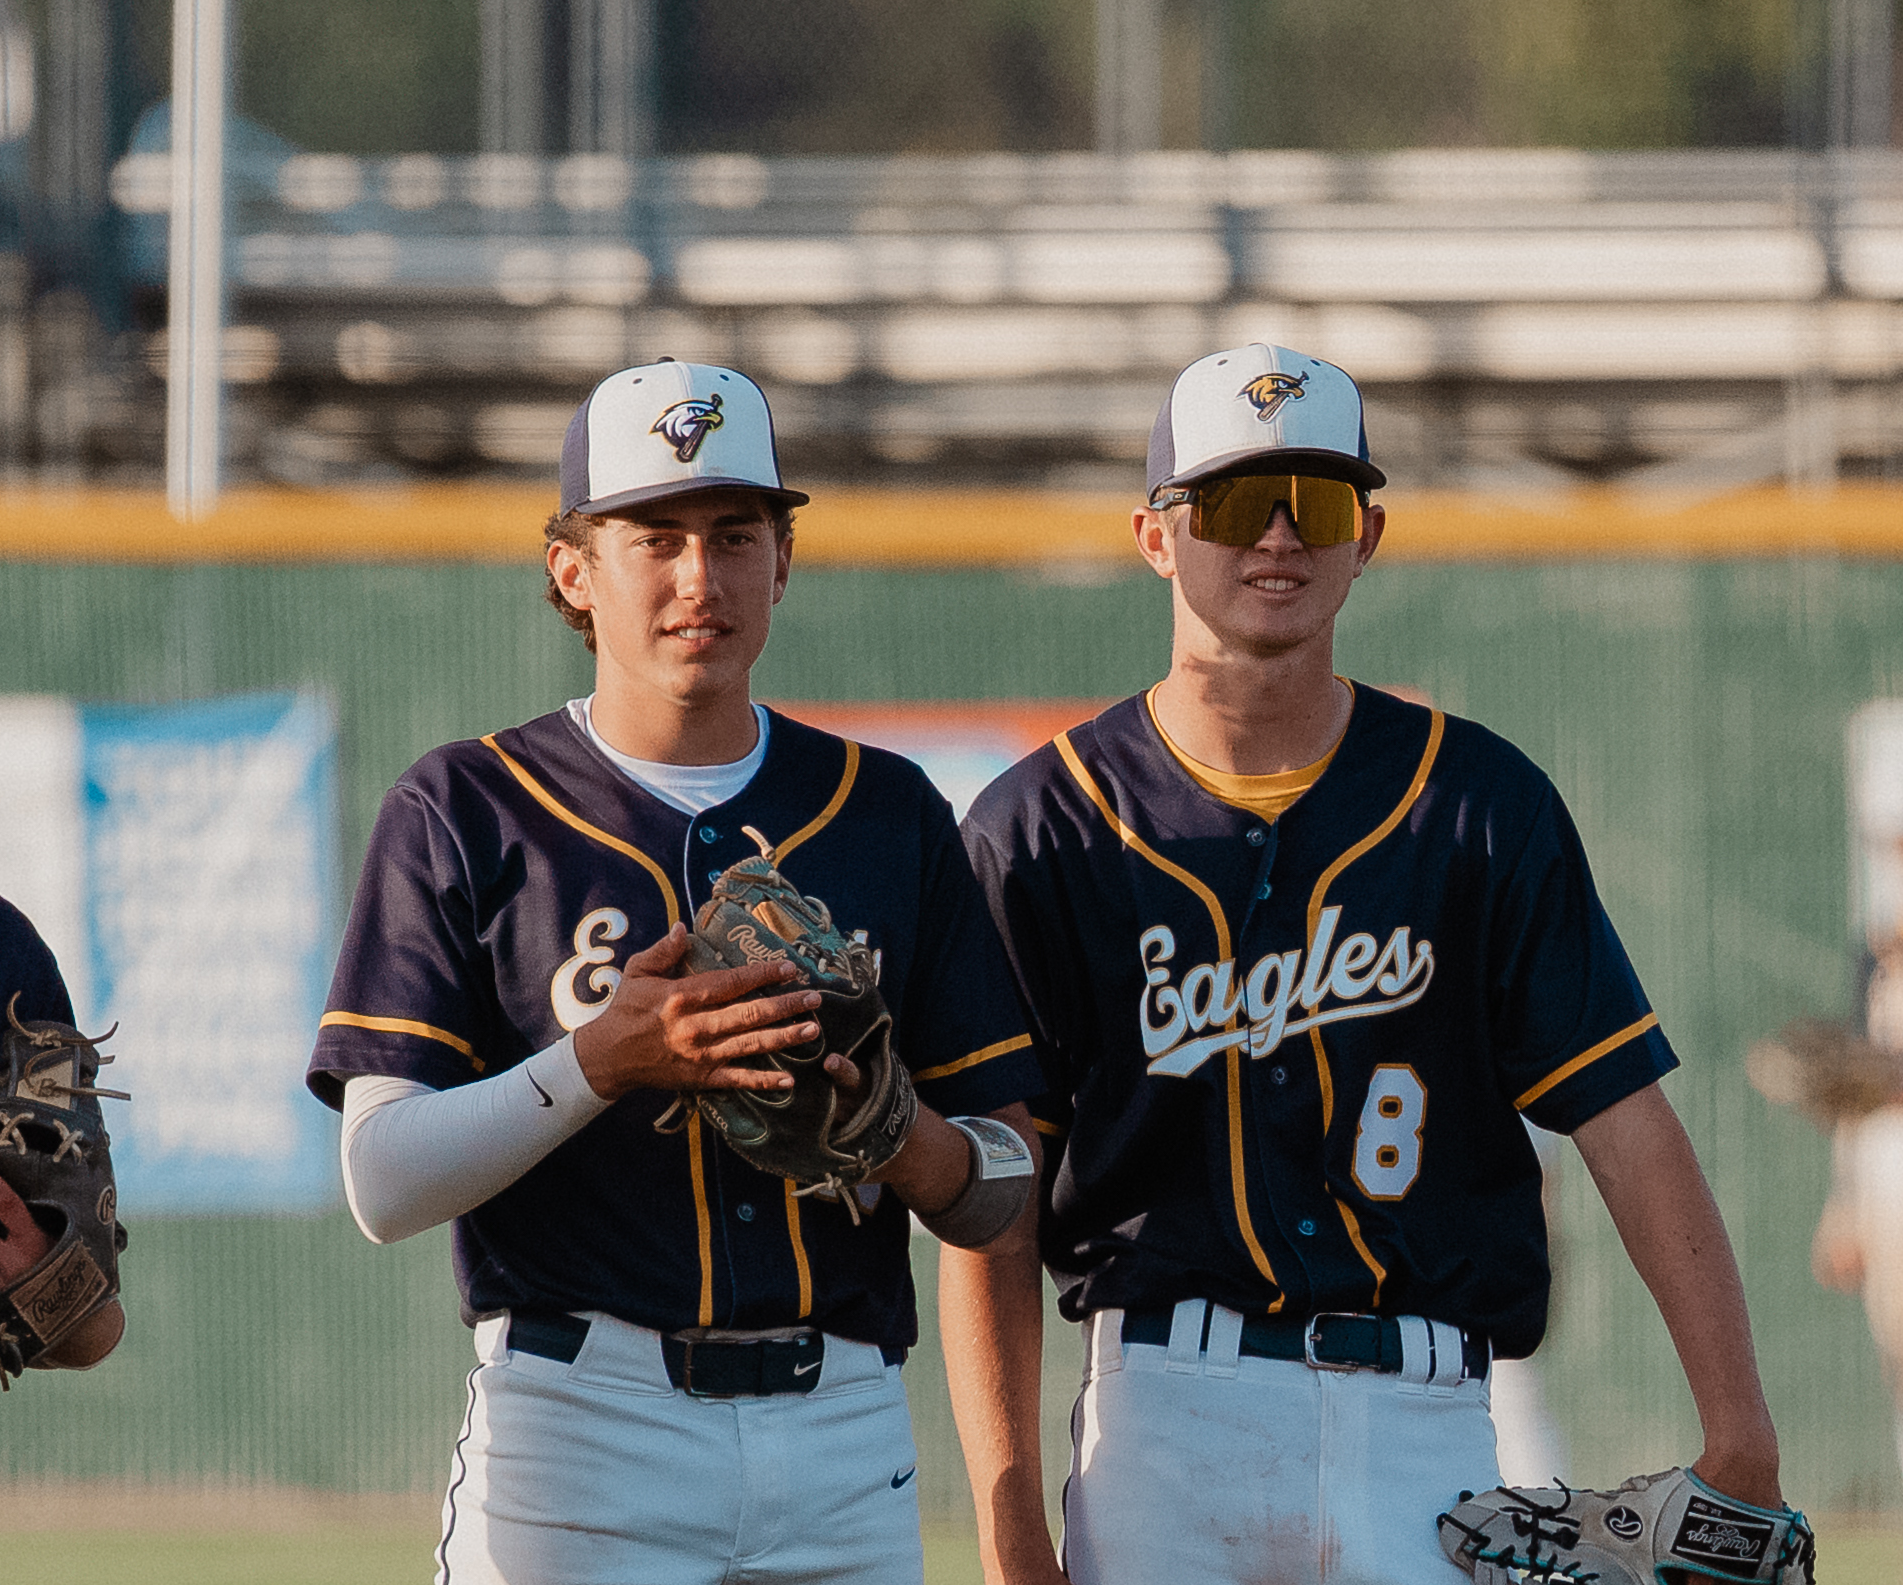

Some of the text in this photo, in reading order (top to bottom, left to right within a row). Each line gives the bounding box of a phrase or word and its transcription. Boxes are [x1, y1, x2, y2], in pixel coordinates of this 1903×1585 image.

[1139, 905, 1427, 1064] Eagles
[1351, 1063, 1427, 1201] 8
[32, 1259, 86, 1324] Rawlings
[1686, 1523, 1761, 1558] Rawlings
